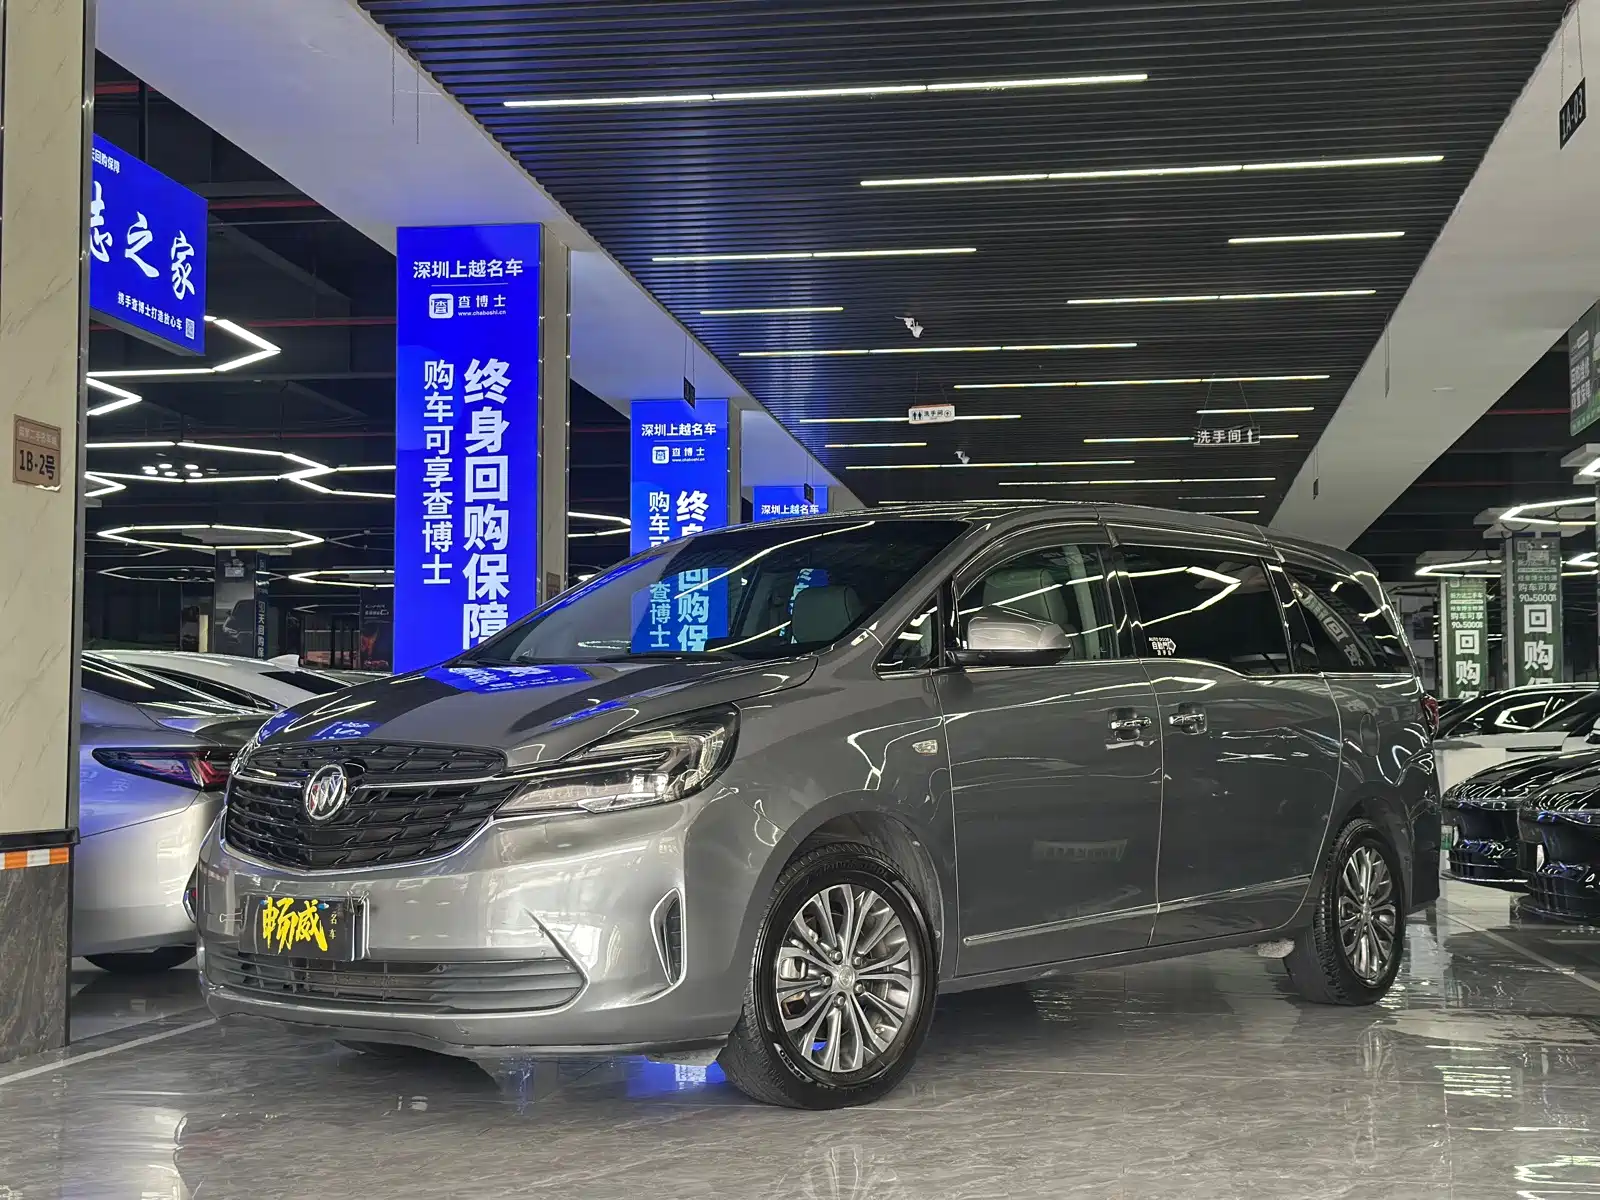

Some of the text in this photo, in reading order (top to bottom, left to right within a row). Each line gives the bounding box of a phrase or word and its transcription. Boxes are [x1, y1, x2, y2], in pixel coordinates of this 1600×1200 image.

[412, 258, 524, 279] 深圳上越名车
[458, 294, 506, 308] 查博士
[117, 291, 182, 331] 携手查博士打造放心车
[641, 422, 717, 437] 深圳上越名车
[1197, 429, 1241, 443] 洗手间
[672, 446, 705, 456] 查博士
[421, 360, 454, 584] 购车可享查博士
[462, 358, 512, 650] 终身回购保障
[761, 504, 820, 515] 深圳上越名车
[1518, 582, 1558, 592] 购车可享
[1450, 612, 1483, 620] 购车可享
[328, 910, 338, 939] 名车
